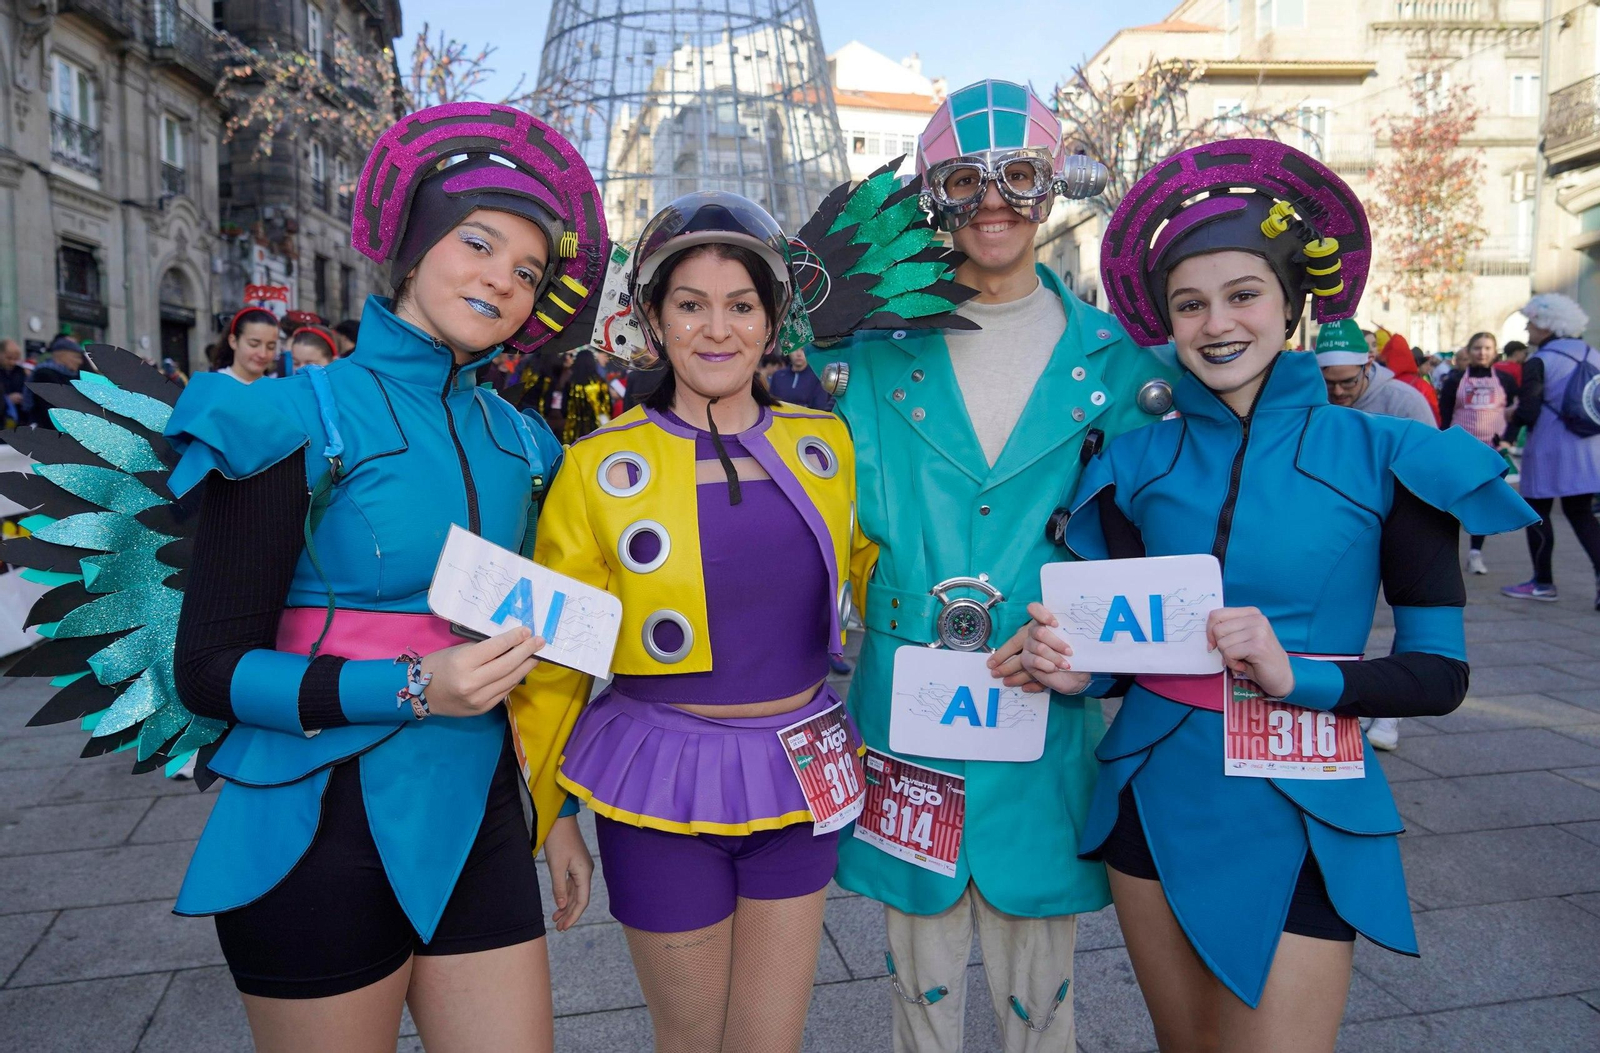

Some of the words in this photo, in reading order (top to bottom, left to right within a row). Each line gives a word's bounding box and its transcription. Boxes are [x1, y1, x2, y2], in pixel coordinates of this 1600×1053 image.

[489, 576, 567, 645] AI
[1099, 594, 1166, 643] AI
[940, 685, 1000, 728] AI
[815, 728, 847, 754] vigo
[1268, 709, 1337, 758] 316
[824, 752, 859, 804] 313
[889, 777, 943, 806] vigo
[900, 776, 938, 791] SILVESTRE
[880, 798, 933, 851] 314
